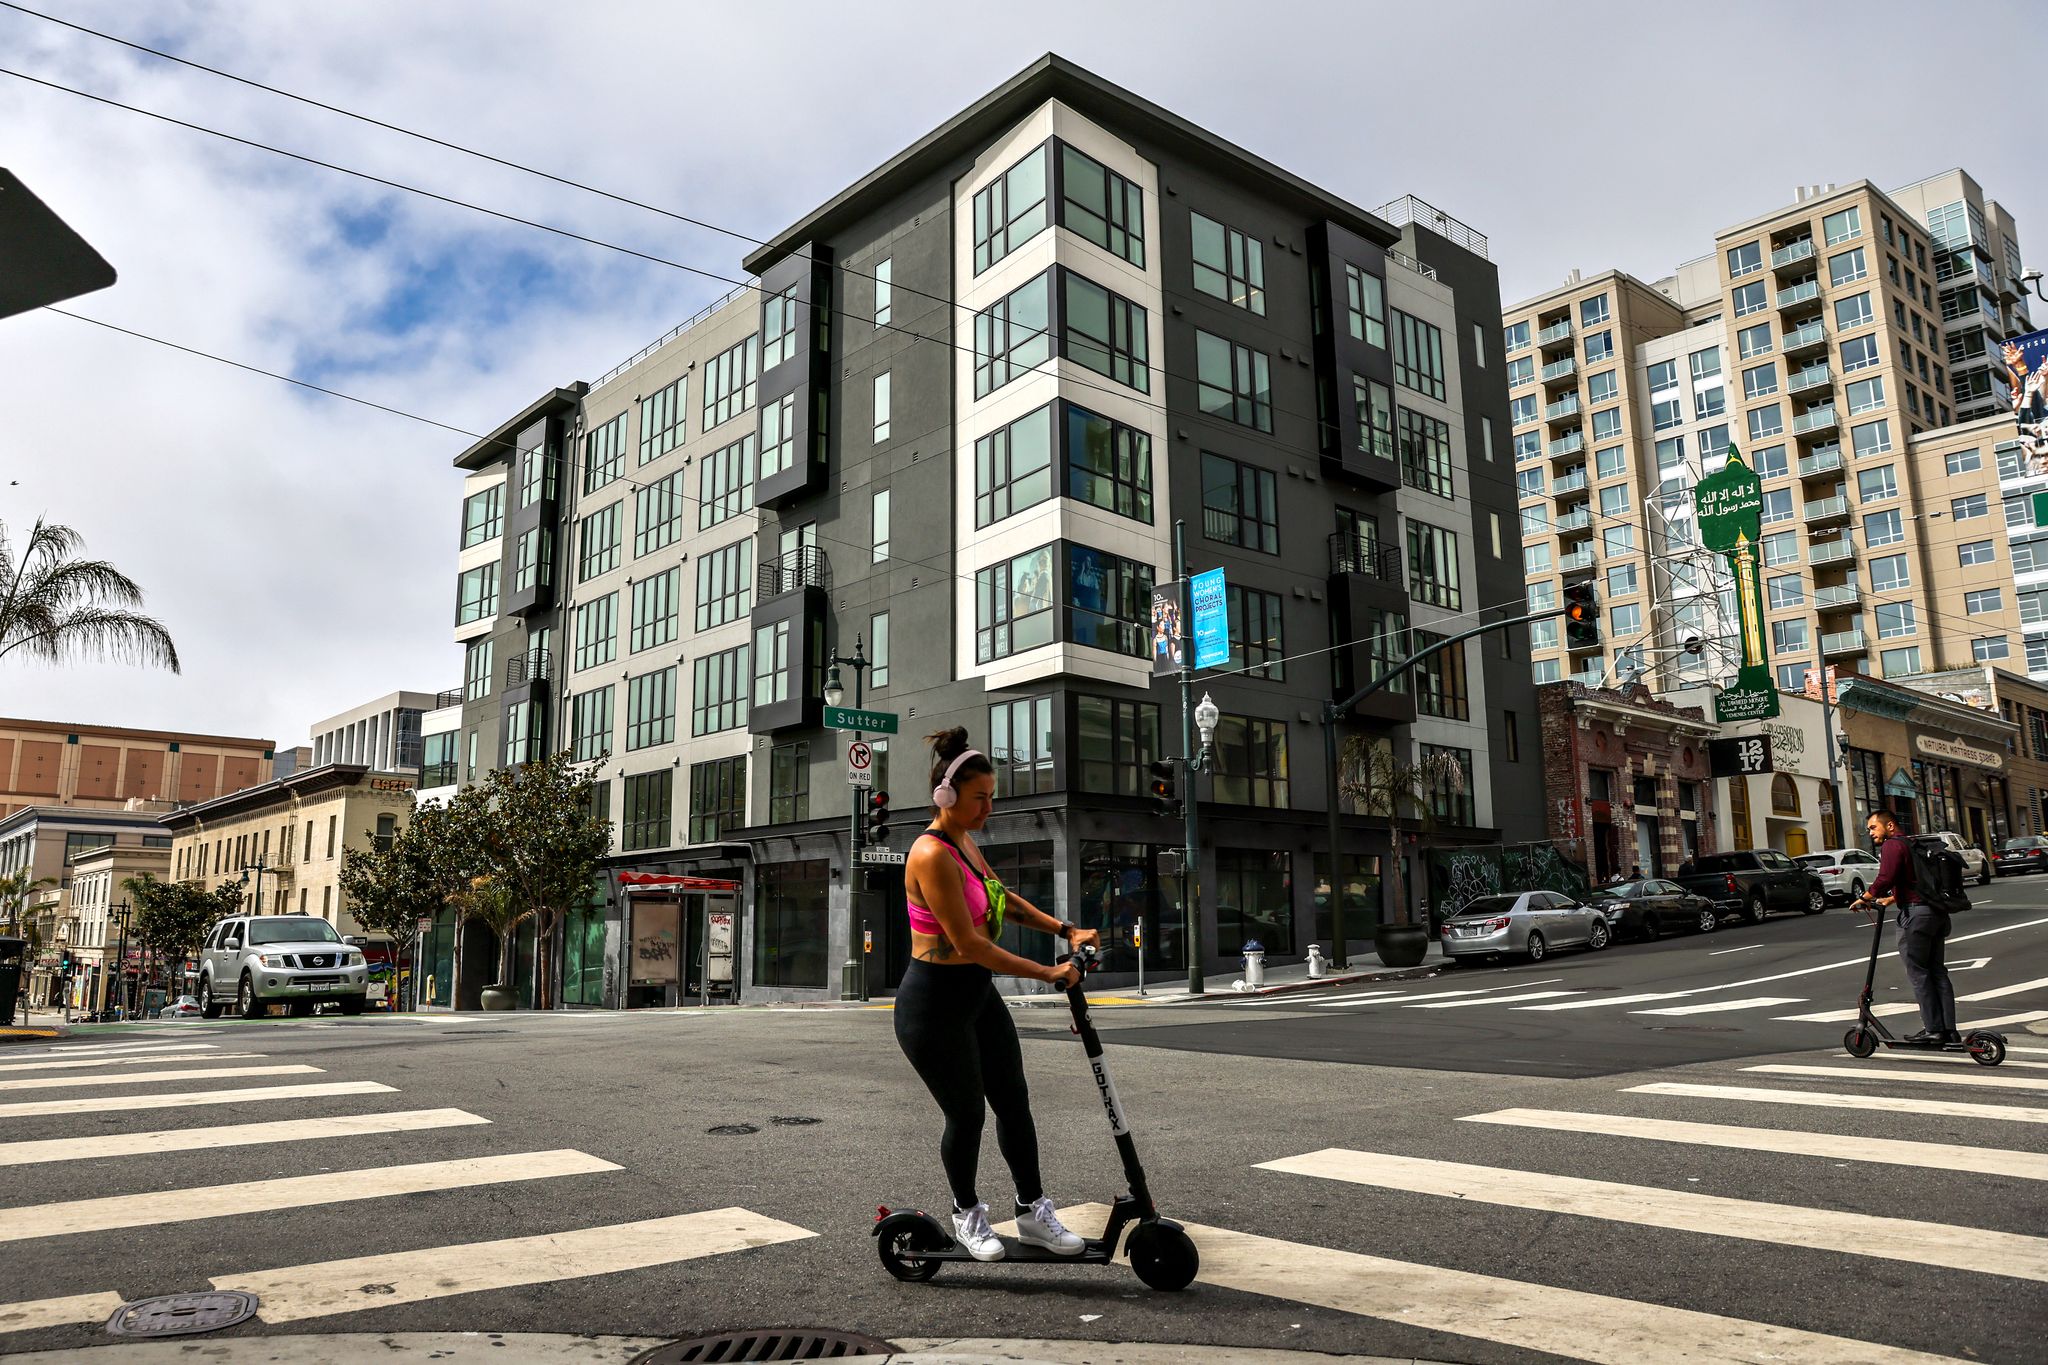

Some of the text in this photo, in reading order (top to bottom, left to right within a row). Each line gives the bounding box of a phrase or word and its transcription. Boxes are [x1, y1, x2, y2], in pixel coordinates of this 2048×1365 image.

[1747, 483, 1754, 494] لا
[1701, 491, 1716, 503] الله
[1698, 500, 1760, 516] محمد رسول الله
[1193, 576, 1222, 590] YOUNG
[1194, 585, 1223, 597] WOMEN'S
[1195, 592, 1223, 606] CHORAL
[1196, 600, 1223, 612] PROJECTS
[1748, 695, 1769, 704] MOSQUE
[837, 712, 887, 729] Sutter
[1738, 739, 1764, 757] 12
[1924, 740, 1996, 764] NATURAL MATTRESS STORE
[1740, 754, 1765, 772] 17
[849, 771, 871, 781] ON RED
[864, 853, 902, 862] SUTTER
[1092, 1062, 1121, 1131] GOTRAX
